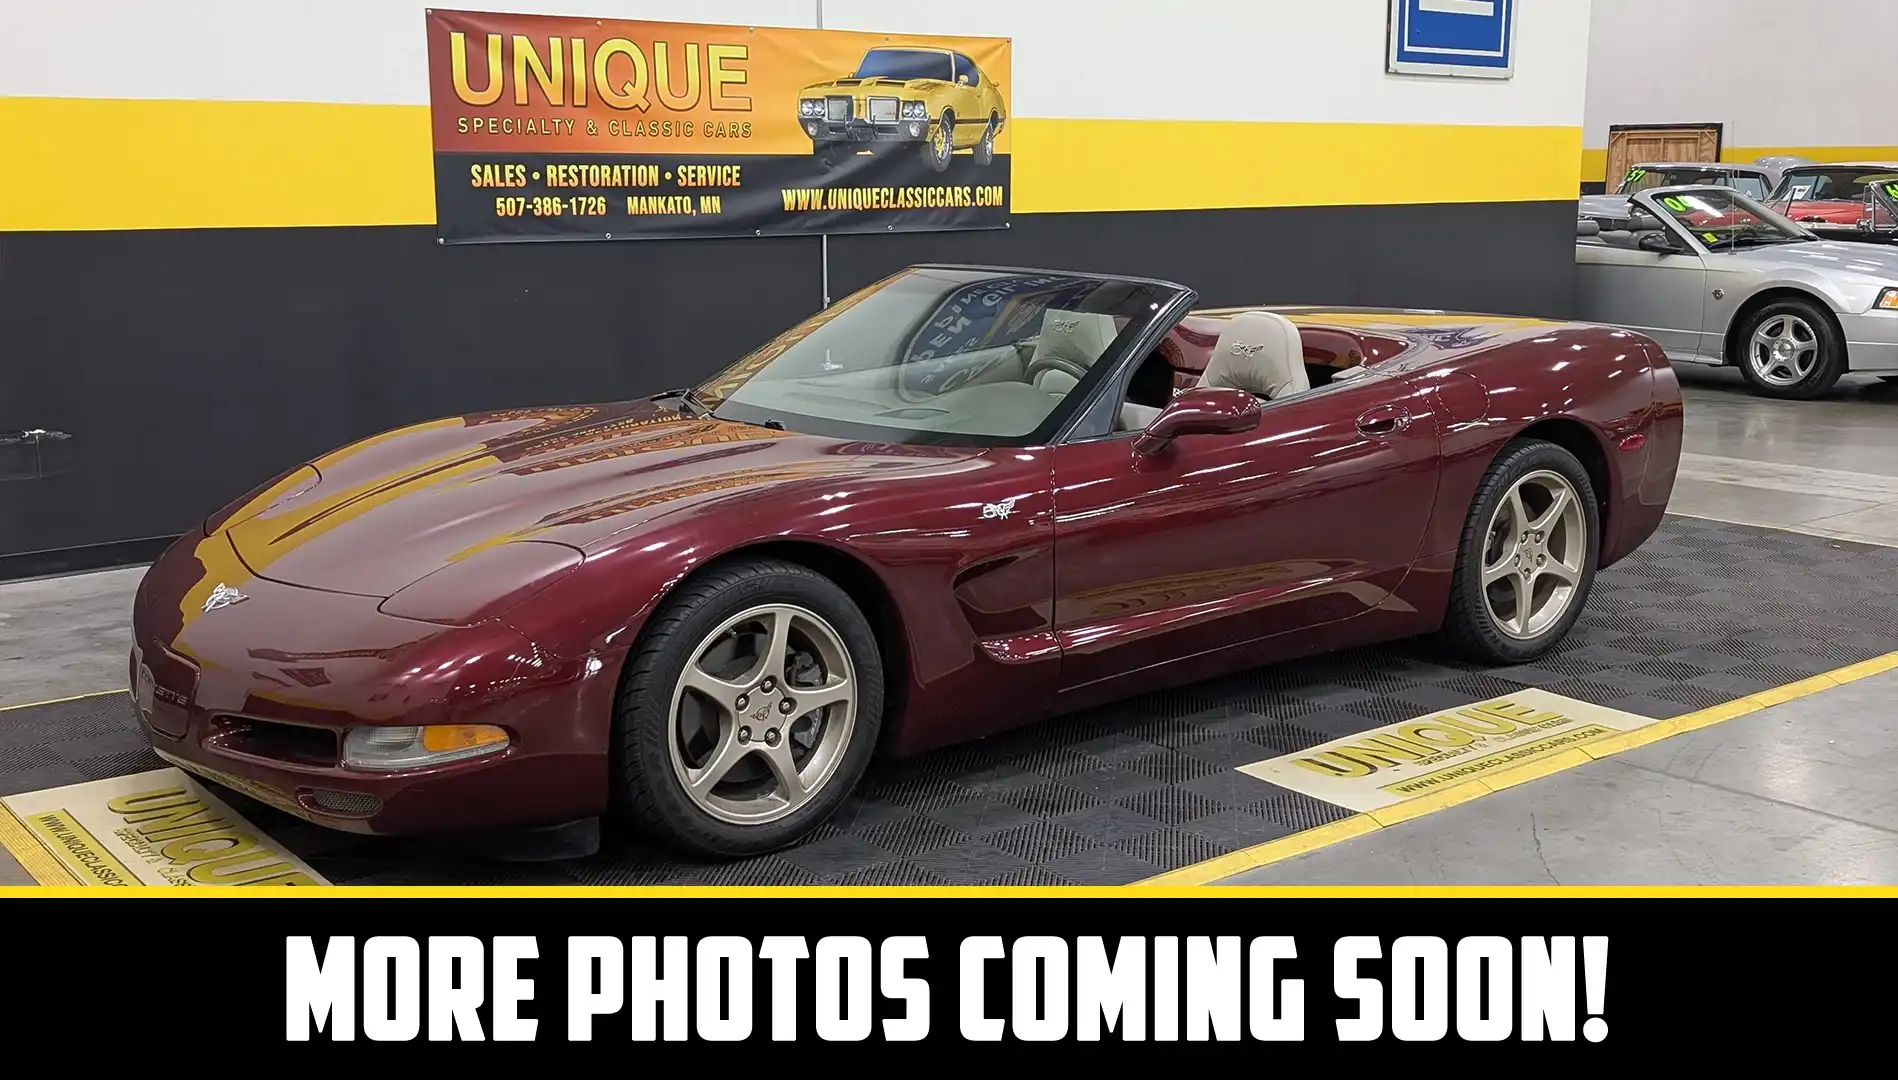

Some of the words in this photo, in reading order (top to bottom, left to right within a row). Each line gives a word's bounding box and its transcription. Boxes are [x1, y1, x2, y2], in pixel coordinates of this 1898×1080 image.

[449, 31, 752, 114] UNIQUE
[458, 117, 575, 135] SPECIALTY
[586, 119, 599, 135] &
[608, 120, 694, 137] CLASSIC
[703, 122, 753, 139] CARS
[471, 164, 526, 188] SALES
[547, 164, 659, 187] RESTORATION
[677, 165, 741, 187] SERVICE
[782, 186, 1003, 211] WWW.UNIQUECLASSICCARS.COM
[496, 196, 606, 217] 507-386-1726
[627, 196, 696, 216] MANKATO,
[700, 196, 721, 214] MN
[1293, 702, 1563, 778] UNIQUE
[1401, 728, 1607, 793] WWW.UNIQUECLASSICCARS.COM
[107, 786, 320, 885] UNIQU
